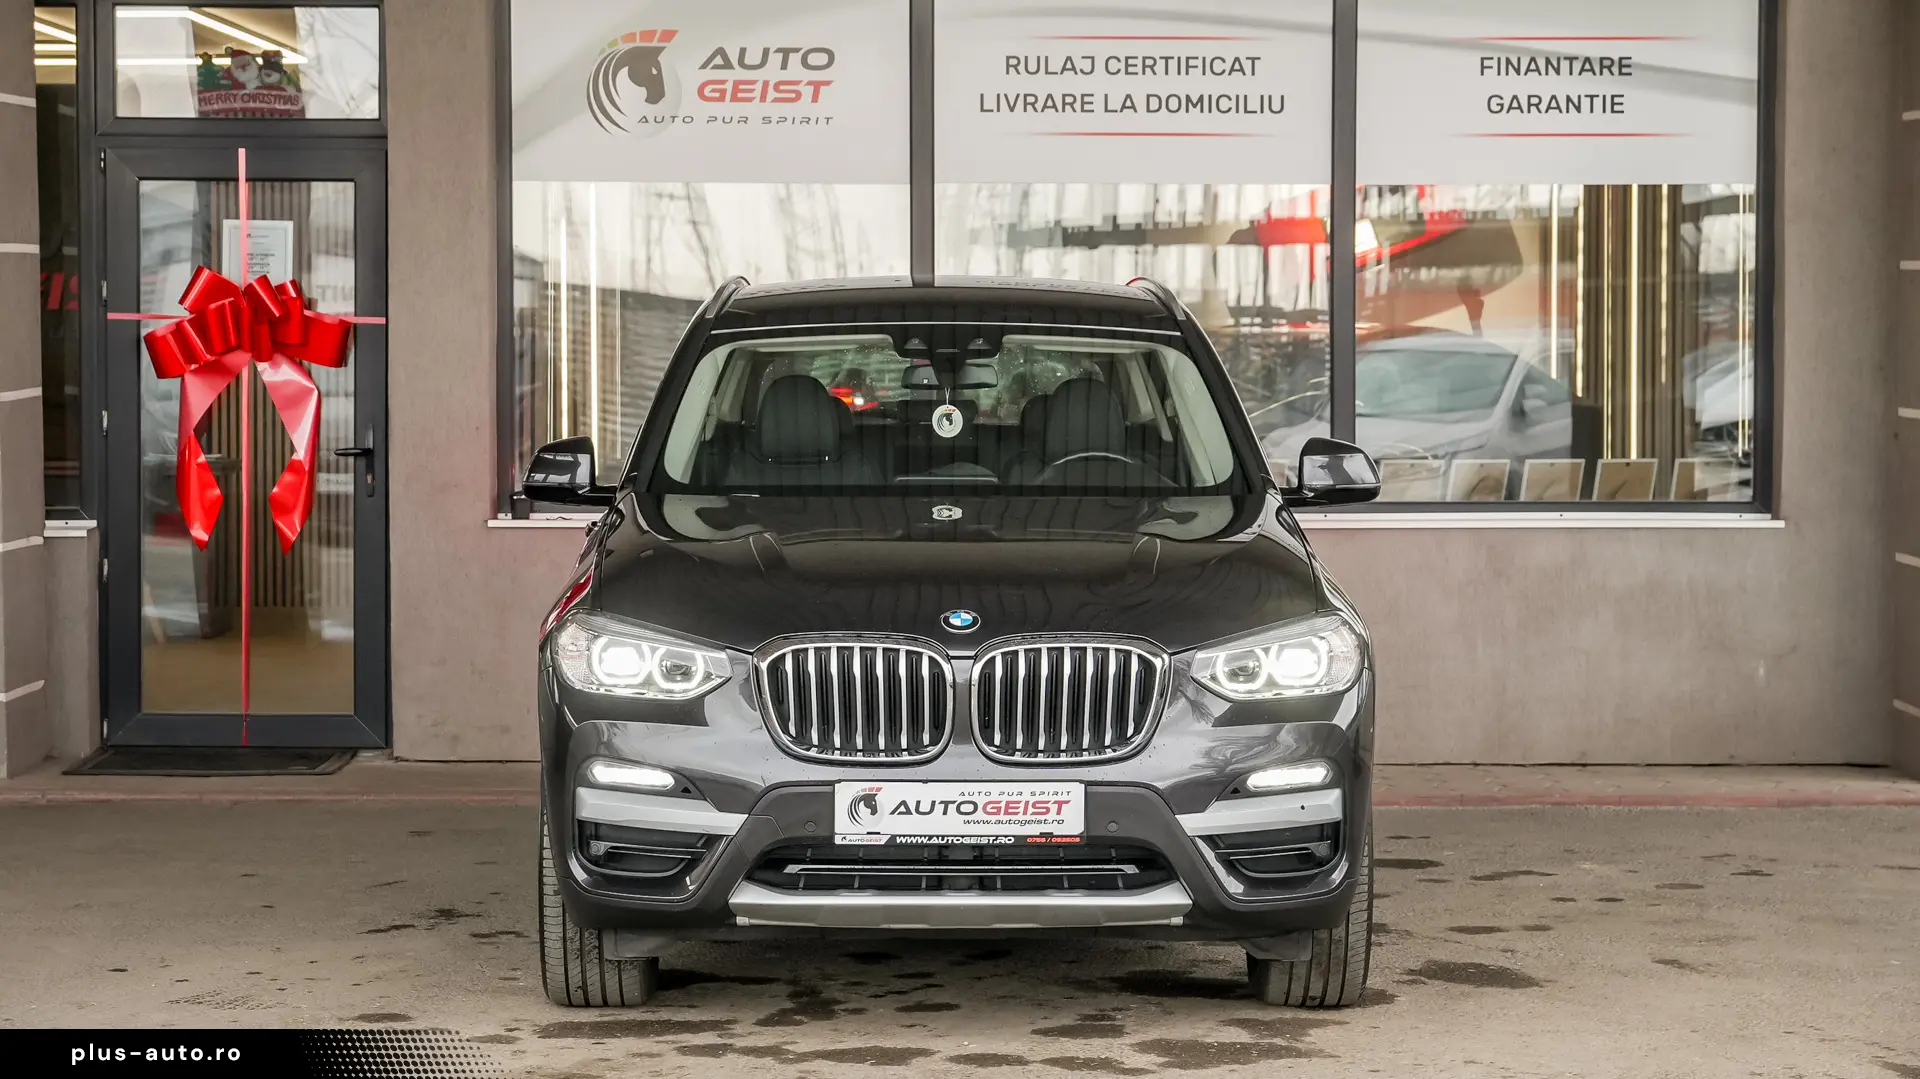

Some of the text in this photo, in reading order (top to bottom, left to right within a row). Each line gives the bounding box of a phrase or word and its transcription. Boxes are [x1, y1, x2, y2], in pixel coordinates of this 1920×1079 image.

[698, 46, 836, 71] AUTO
[1005, 55, 1262, 77] RULAJ CERTIFICAT
[1480, 56, 1633, 77] FINANTARE
[198, 92, 300, 107] MERRY CHRISTMAS
[697, 79, 835, 103] GEIST
[979, 92, 1286, 115] LIVRARE LA DOMICILIU
[1486, 94, 1625, 115] GARANTIE
[637, 115, 833, 125] AUTO PUR SPIRIT
[963, 818, 1065, 827] www.autogeist.ro
[896, 836, 1015, 844] WWW.AUTOGEIST.RO
